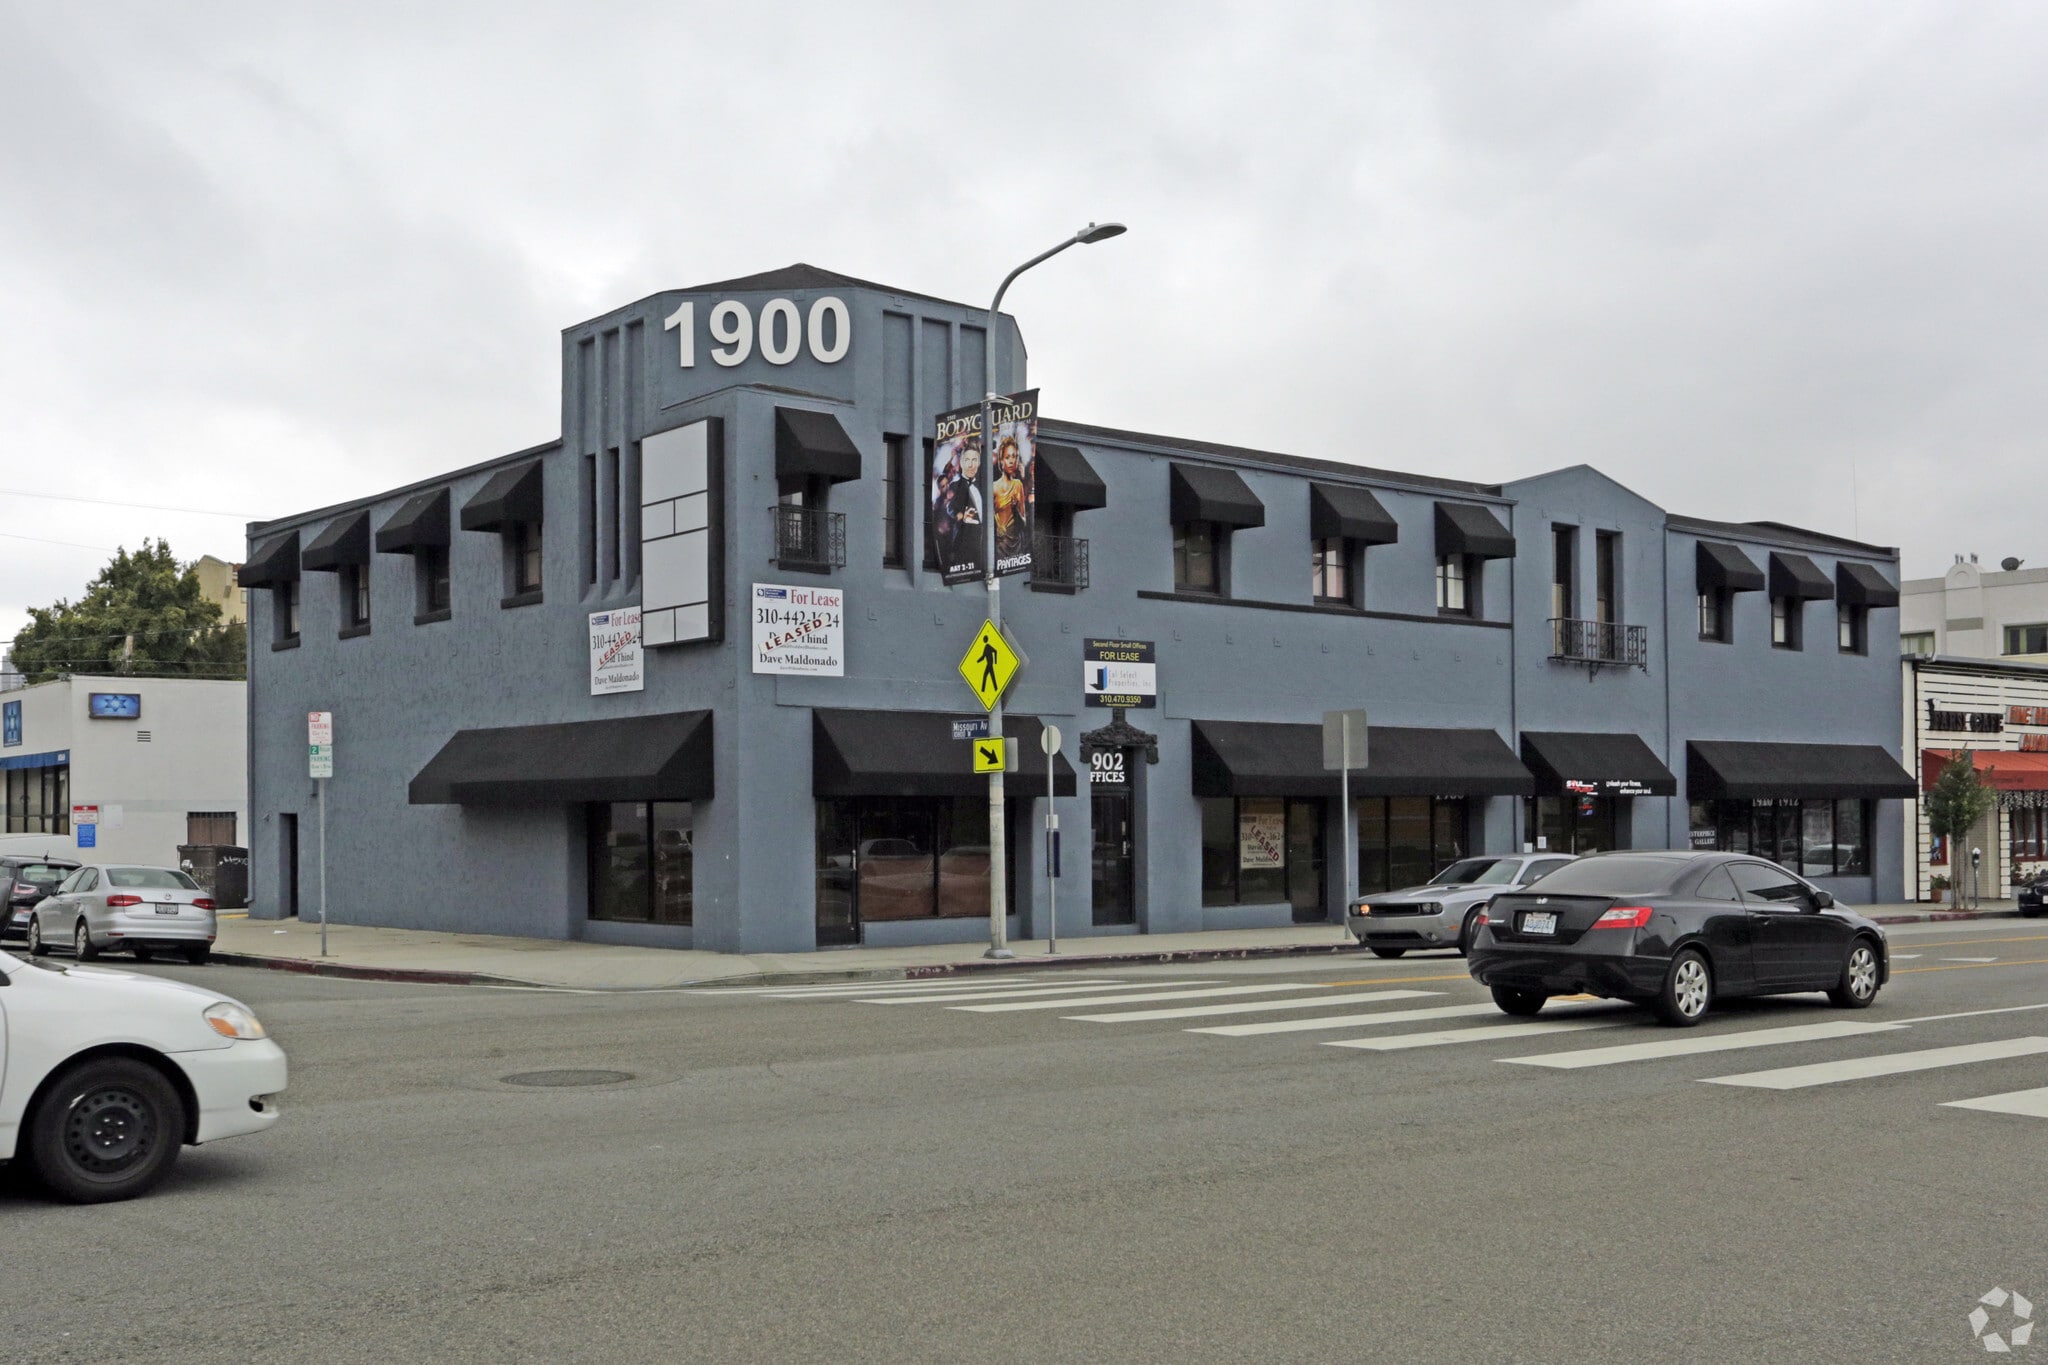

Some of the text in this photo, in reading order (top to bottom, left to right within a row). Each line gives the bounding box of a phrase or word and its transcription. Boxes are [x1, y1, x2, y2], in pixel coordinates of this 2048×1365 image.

[664, 296, 851, 368] 1900
[997, 553, 1031, 570] PANTAGES
[791, 589, 808, 605] For
[811, 590, 840, 607] Lease
[611, 614, 622, 627] For
[765, 619, 822, 650] LEASED
[599, 631, 631, 665] LEASED
[1100, 651, 1140, 661] FOR LEASE
[760, 653, 838, 667] Dave Maldonado
[594, 671, 639, 686] Dave Maldonado
[1251, 825, 1280, 861] LEASED
